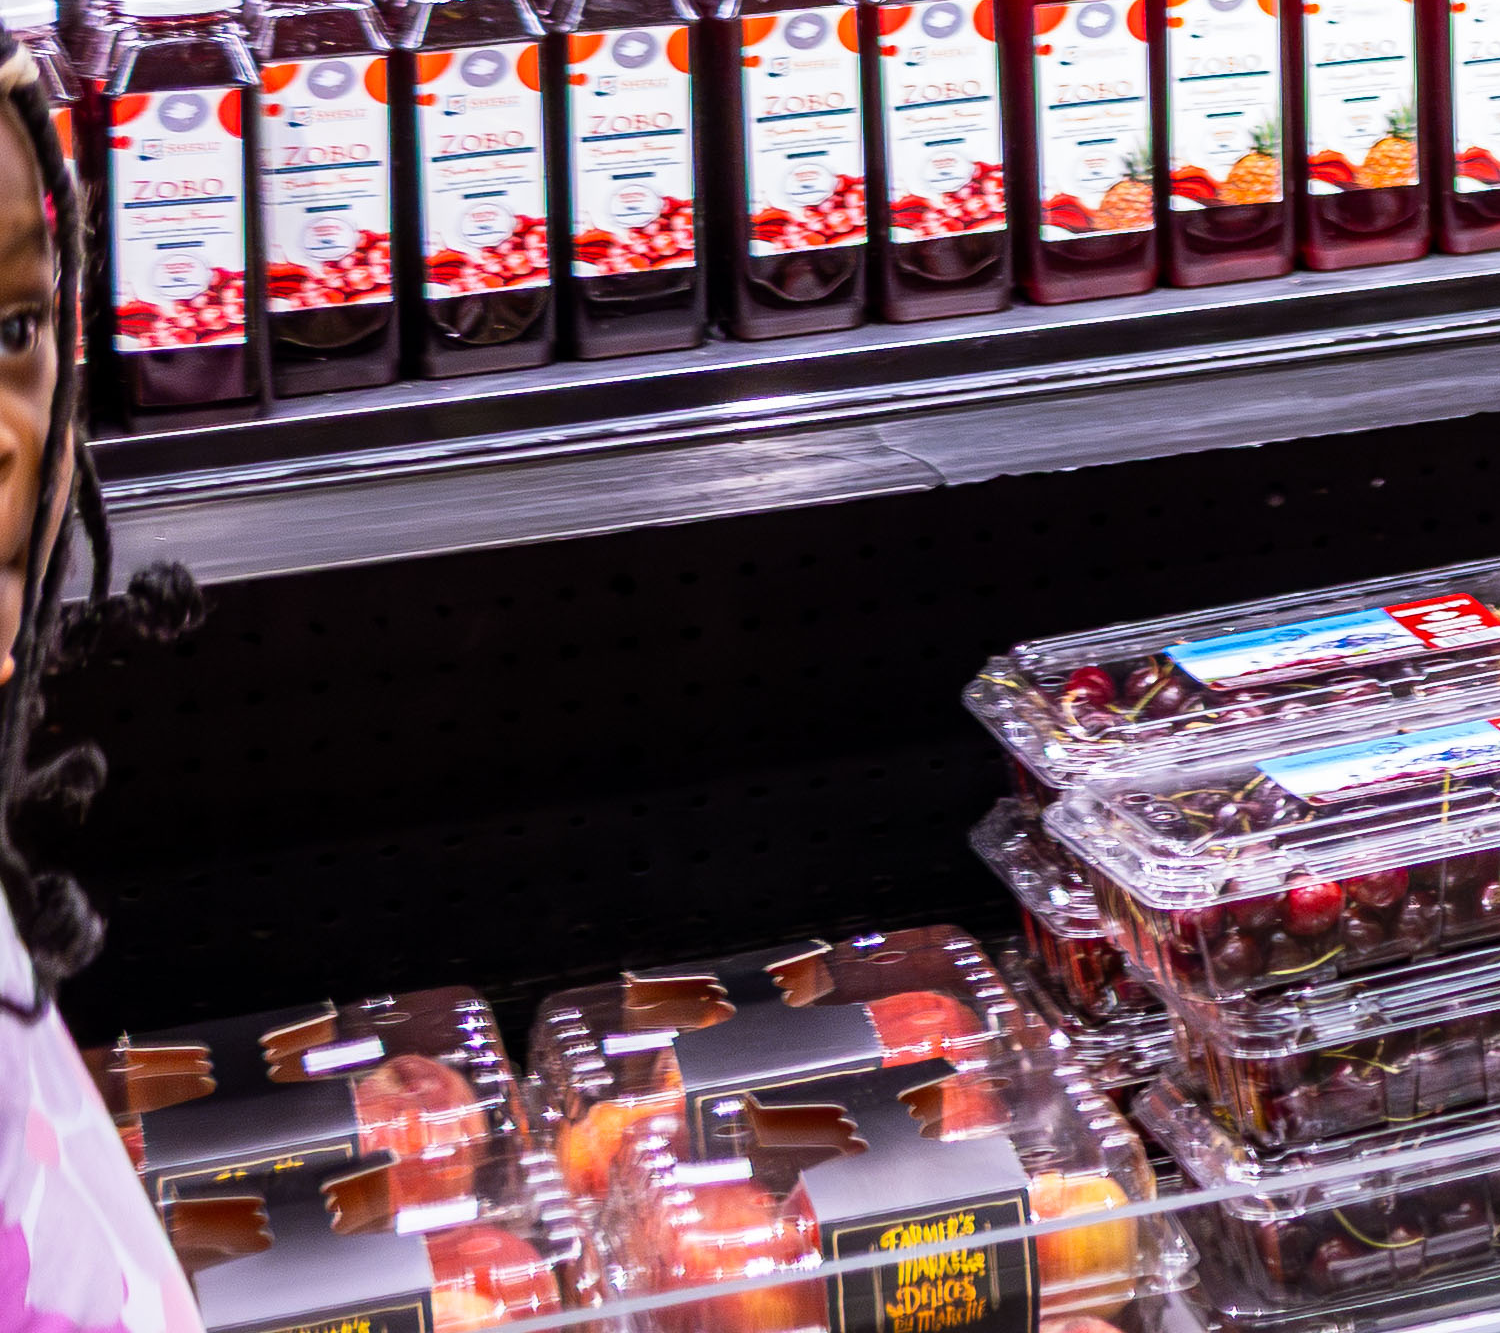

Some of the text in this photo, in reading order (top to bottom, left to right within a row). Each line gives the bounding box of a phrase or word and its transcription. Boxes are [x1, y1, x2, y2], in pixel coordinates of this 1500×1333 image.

[1185, 53, 1262, 74] ZOBO
[903, 80, 981, 102] ZOBO
[1056, 80, 1133, 101] ZOBO
[763, 92, 845, 114] ZOBO
[590, 112, 673, 134] ZOBO
[440, 130, 525, 152] ZOBO
[282, 144, 371, 165] ZOBO
[131, 177, 224, 200] ZOBO
[879, 1211, 975, 1252] FARMER'S
